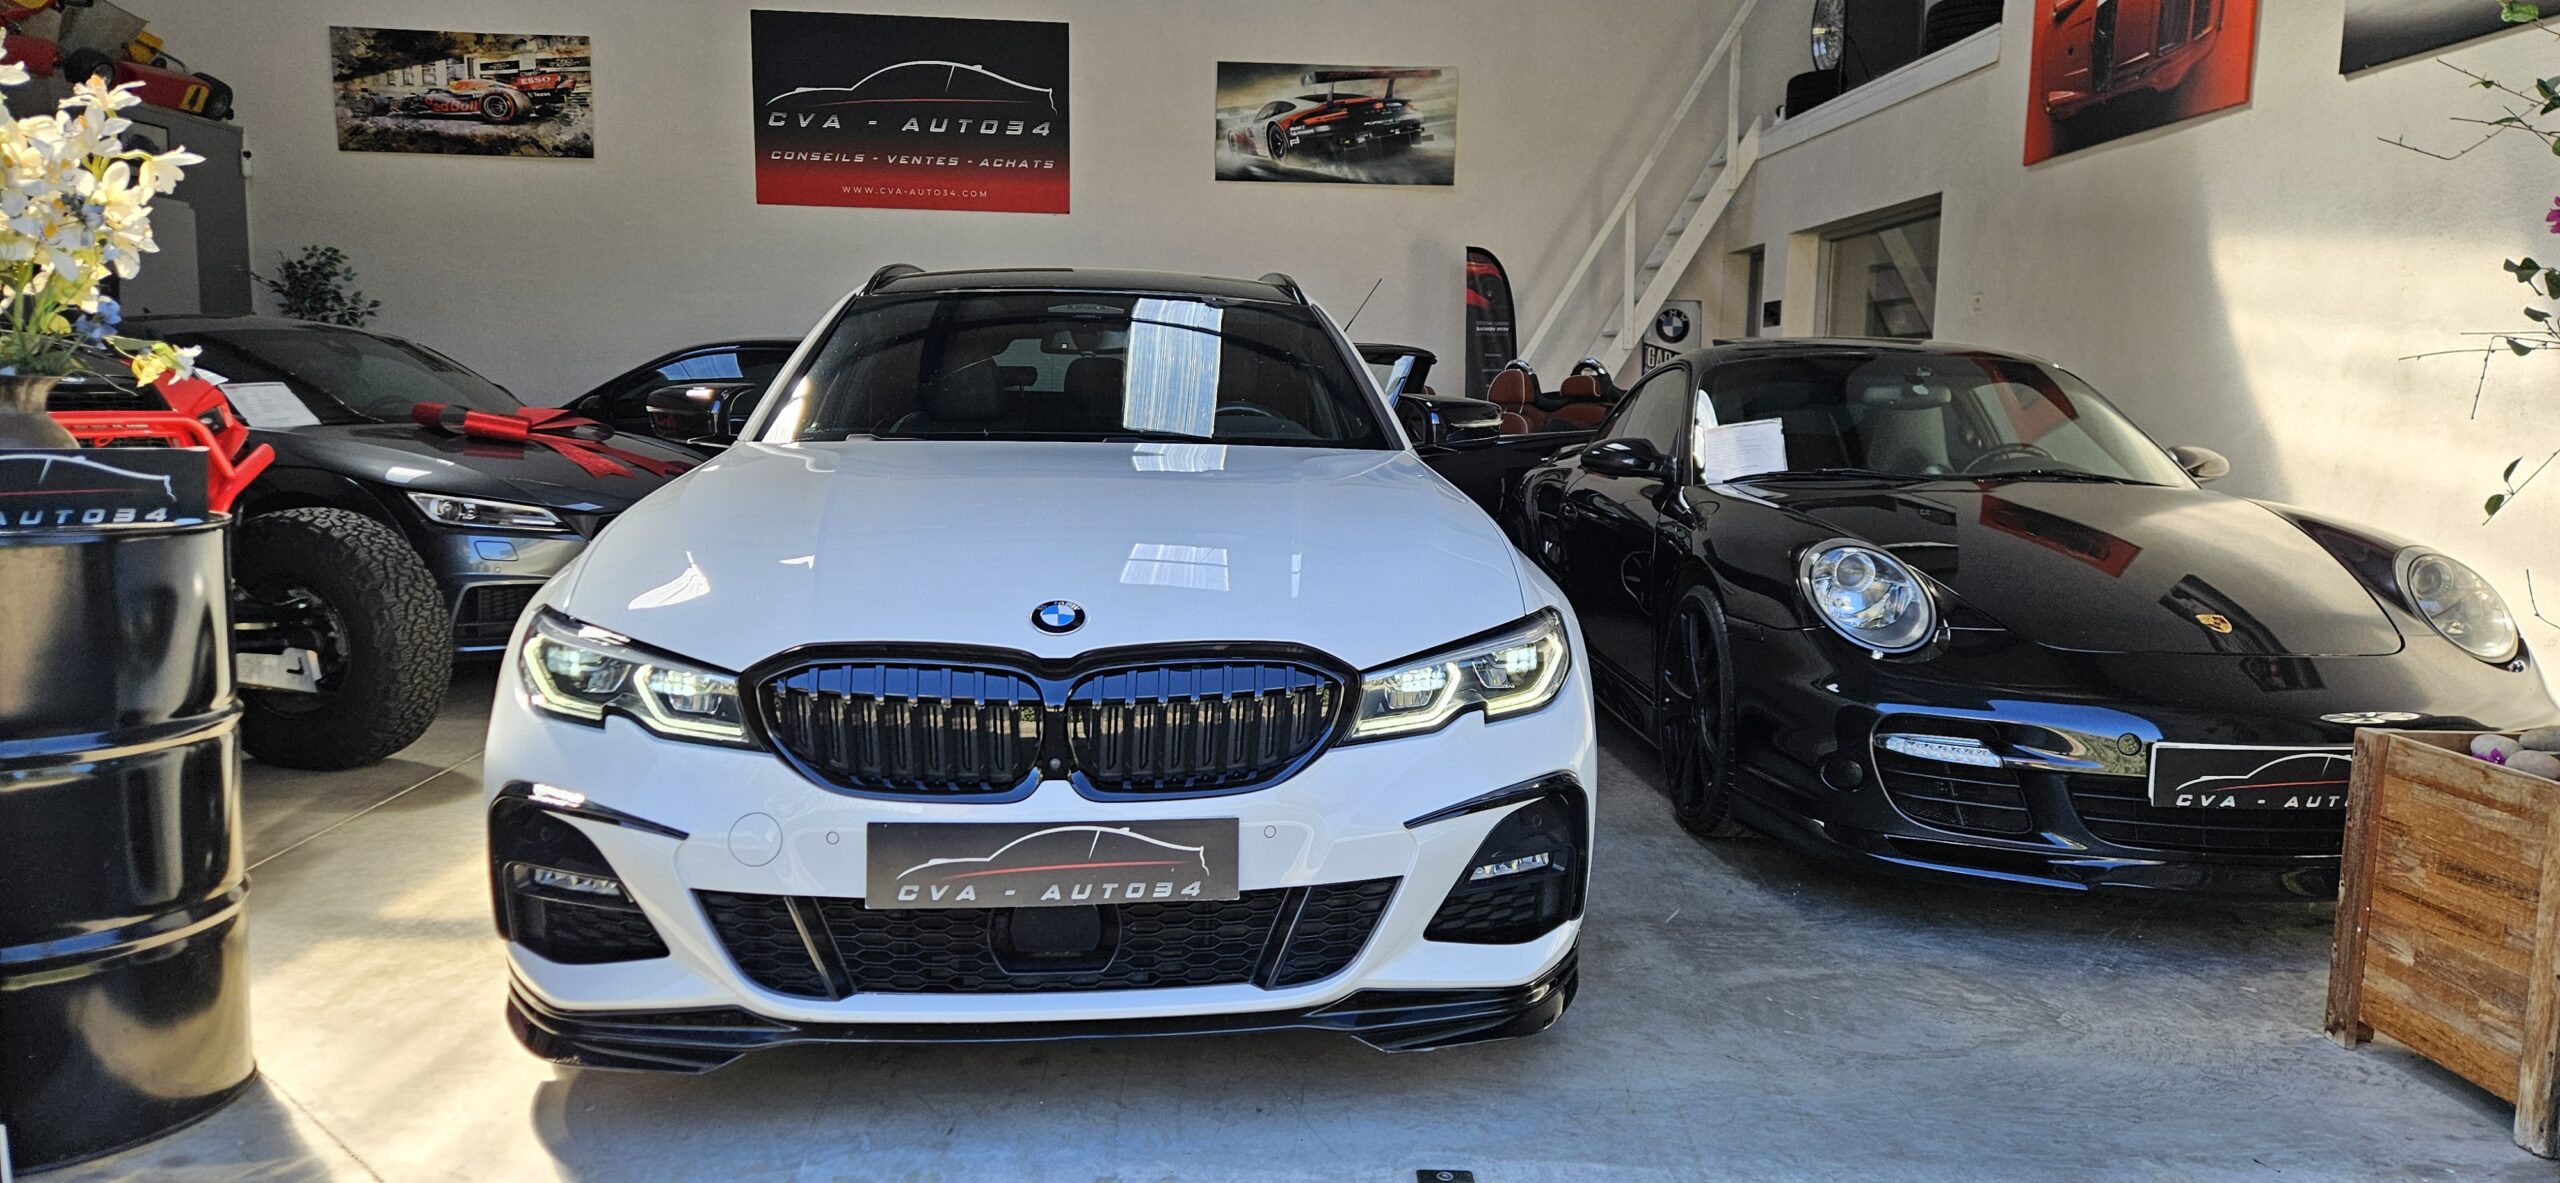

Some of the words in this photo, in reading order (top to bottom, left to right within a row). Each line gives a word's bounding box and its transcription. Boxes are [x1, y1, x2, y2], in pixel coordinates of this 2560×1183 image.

[520, 76, 551, 85] ESSO
[768, 111, 841, 129] CVA
[901, 117, 1051, 136] AUTO34
[771, 150, 865, 163] CONSEILS
[887, 155, 959, 166] VENTES
[979, 158, 1055, 169] ACHATS
[842, 185, 987, 198] WWW.CVA-AUTO34.COM
[1660, 310, 1689, 322] BMW
[2175, 794, 2236, 808] CVA
[2284, 795, 2349, 808] AUT
[898, 885, 976, 901] CVA
[1040, 881, 1202, 900] AUTO34
